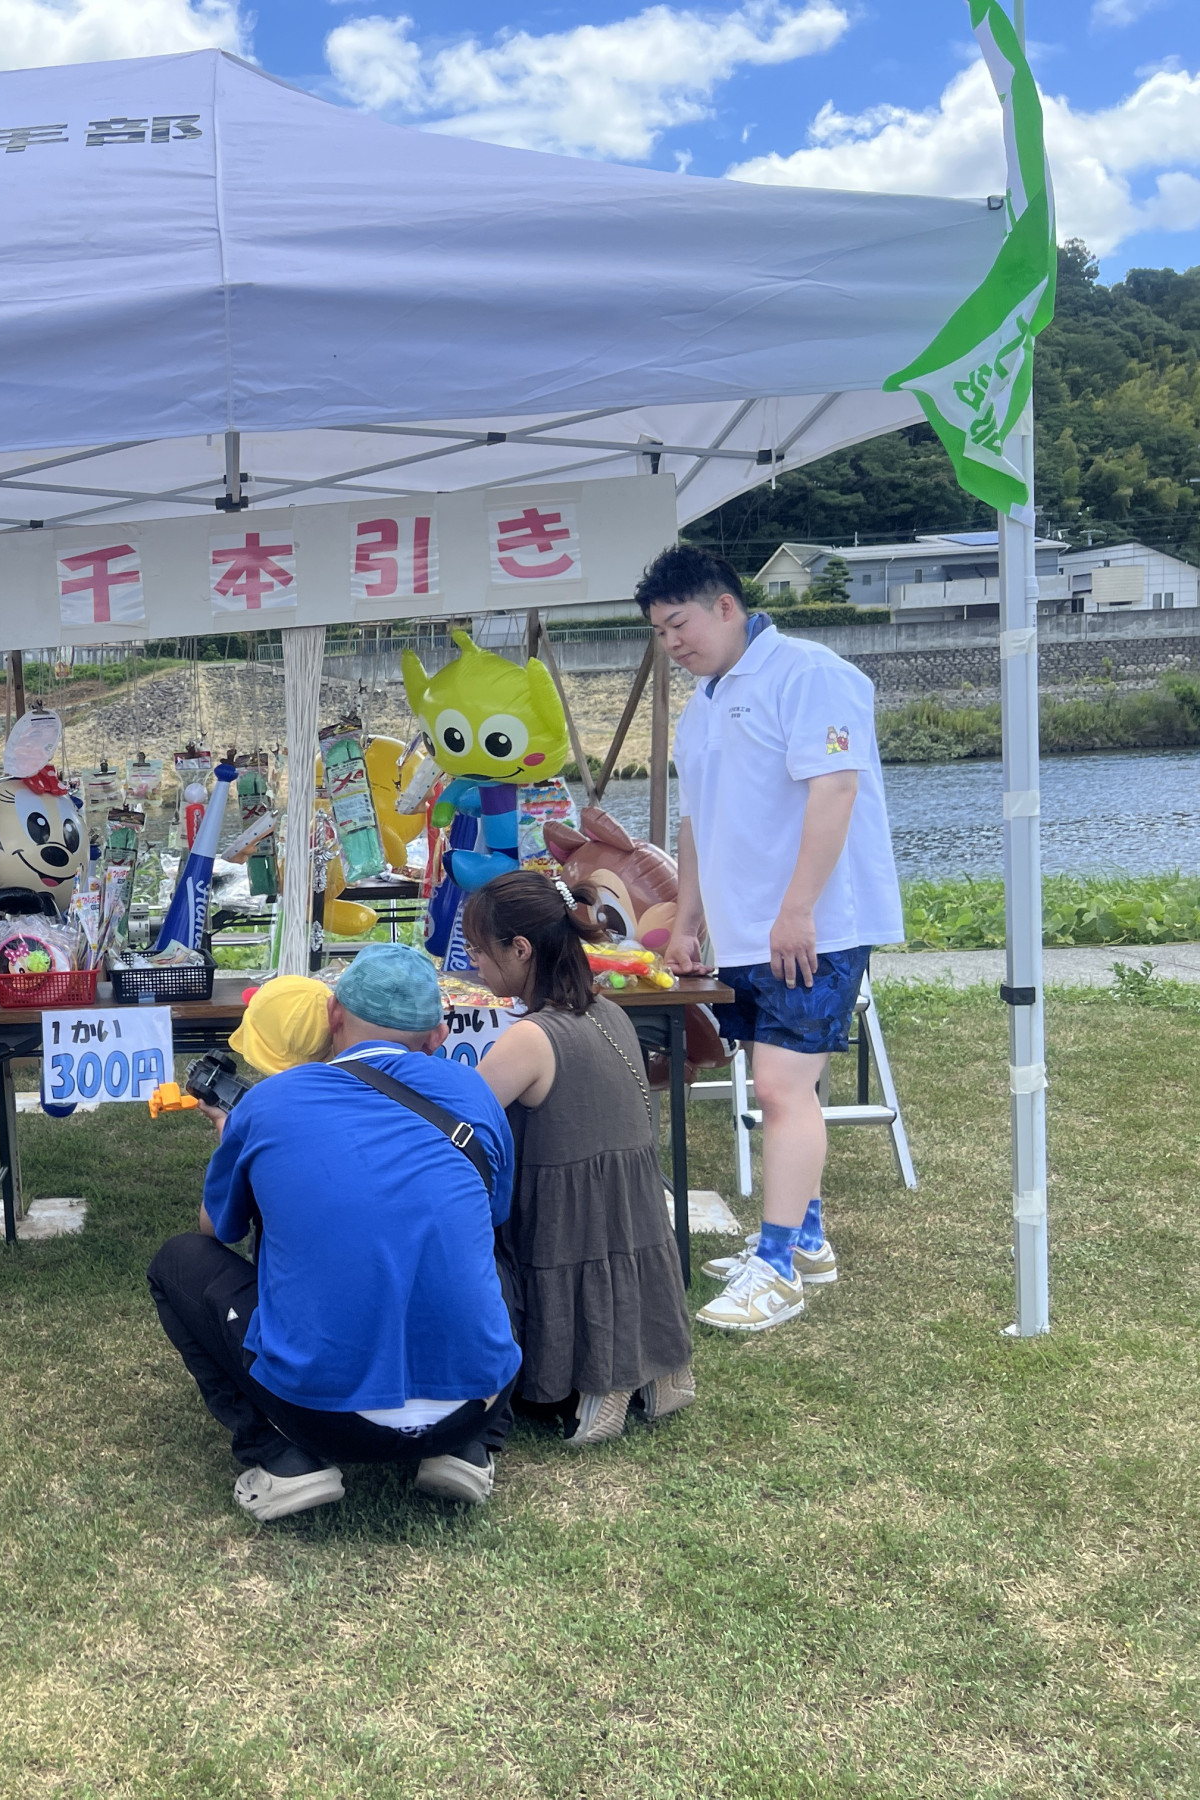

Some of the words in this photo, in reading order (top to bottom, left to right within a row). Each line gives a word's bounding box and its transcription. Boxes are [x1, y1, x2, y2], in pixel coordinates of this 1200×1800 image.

[60, 508, 572, 623] 千本引き
[51, 1048, 166, 1099] 300円
